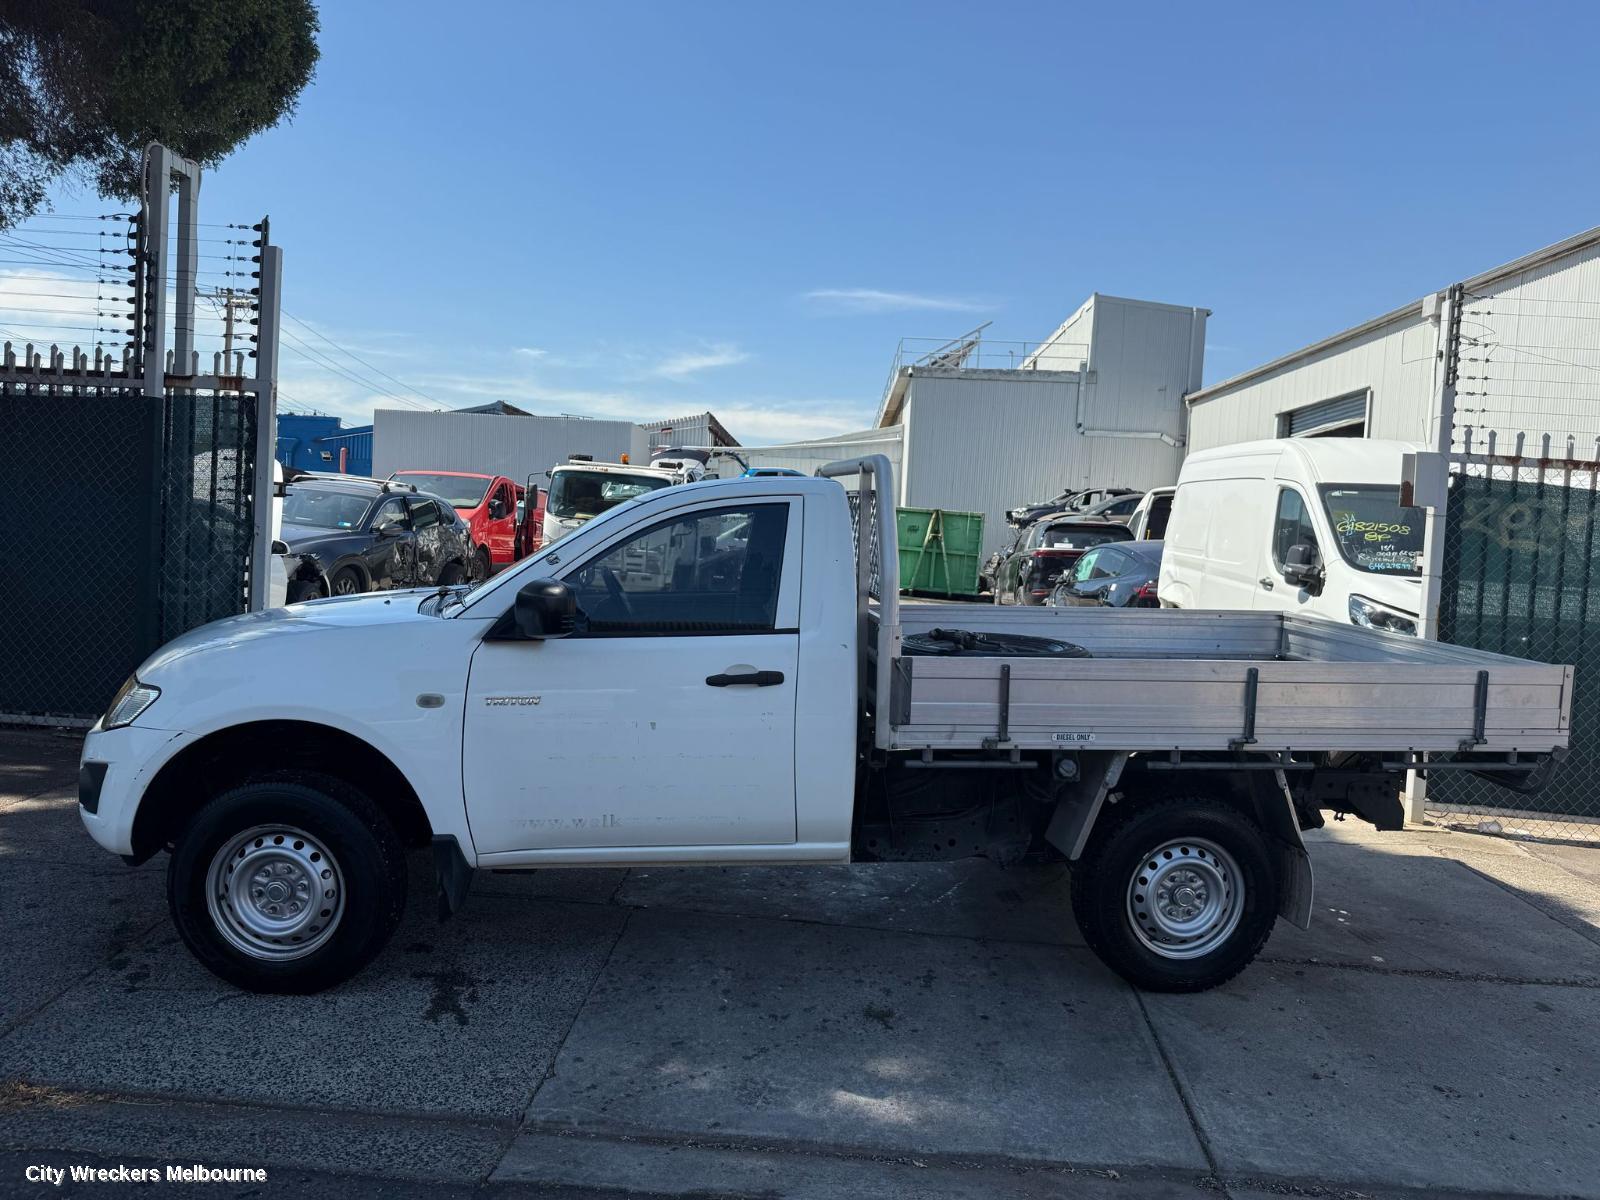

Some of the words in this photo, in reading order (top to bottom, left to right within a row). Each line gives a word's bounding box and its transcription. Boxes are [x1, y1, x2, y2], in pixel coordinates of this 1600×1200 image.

[484, 695, 541, 706] TRITON
[1056, 733, 1075, 741] DIESEL
[1076, 733, 1091, 741] ONLY
